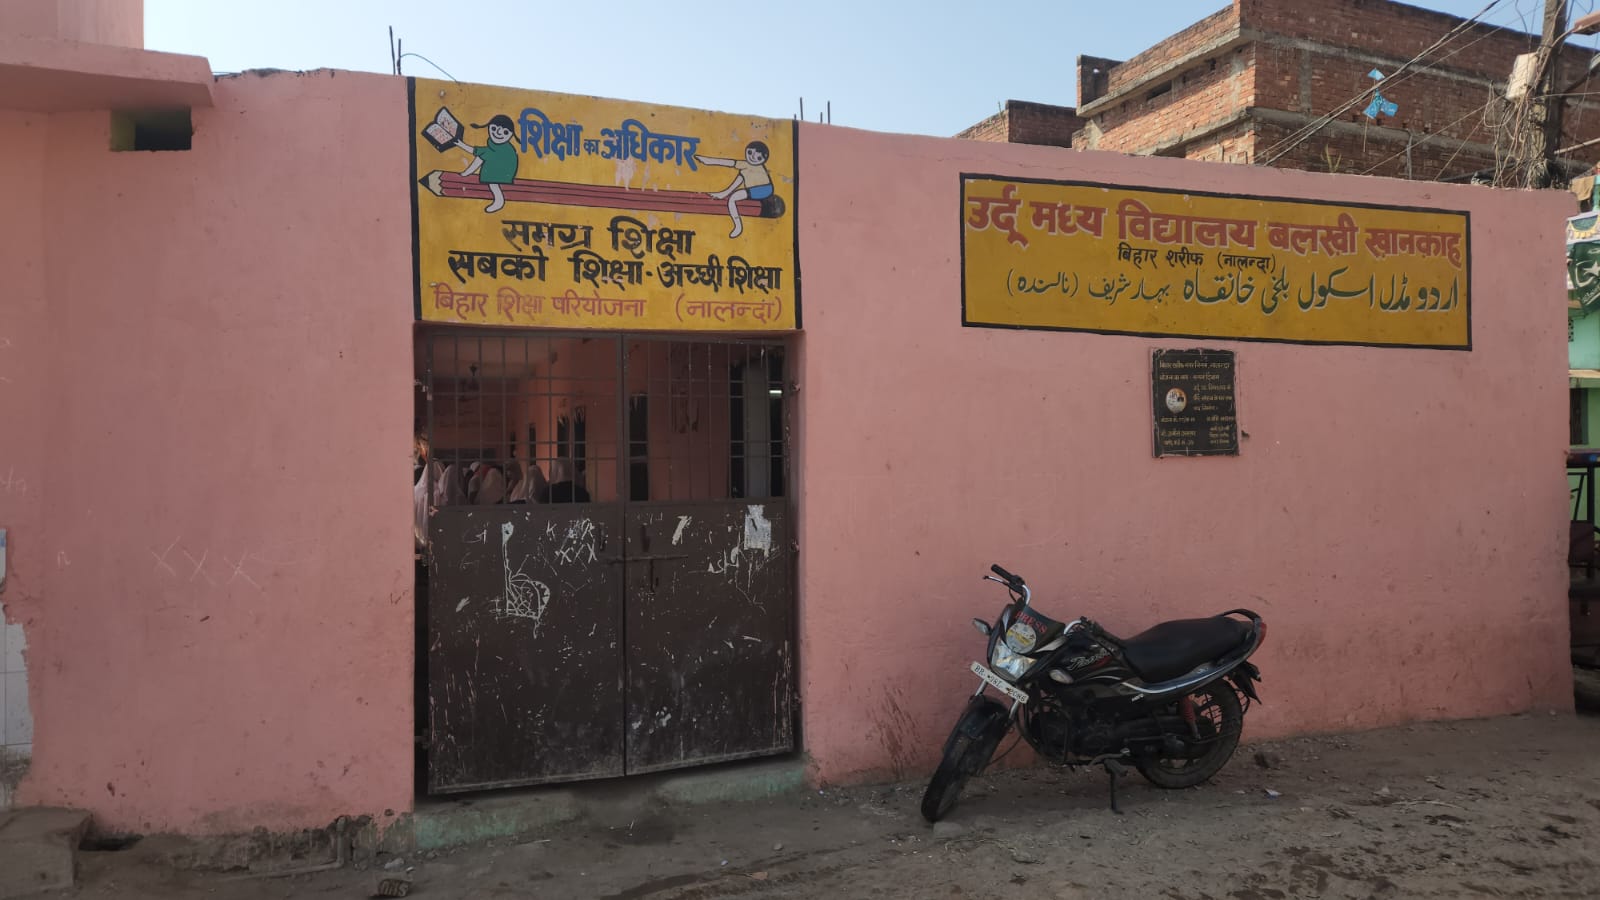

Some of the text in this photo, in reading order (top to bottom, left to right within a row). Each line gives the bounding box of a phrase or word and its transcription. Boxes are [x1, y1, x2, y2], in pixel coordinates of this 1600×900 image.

[517, 107, 701, 171] शिक्षा का अधिकार
[967, 184, 1029, 249] उर्दू
[1029, 200, 1108, 239] मध्य
[1116, 198, 1259, 250] विद्यालय
[501, 215, 696, 261] समग्र शिक्षा
[1117, 241, 1158, 269] बिहार
[1166, 247, 1204, 268] शरीफ
[448, 245, 549, 284] सबको
[727, 256, 783, 294] शिक्षा
[1088, 273, 1131, 306] شریف
[1183, 268, 1255, 304] خانقاہ
[1261, 265, 1290, 314] بلخی
[1298, 266, 1375, 313] اسکول
[434, 282, 489, 320] बिहार
[497, 286, 545, 322] शिक्षा
[551, 289, 647, 317] परियोजना
[1379, 271, 1412, 312] مڈل
[1416, 273, 1460, 311] اردو
[1015, 610, 1048, 634] PRESS
